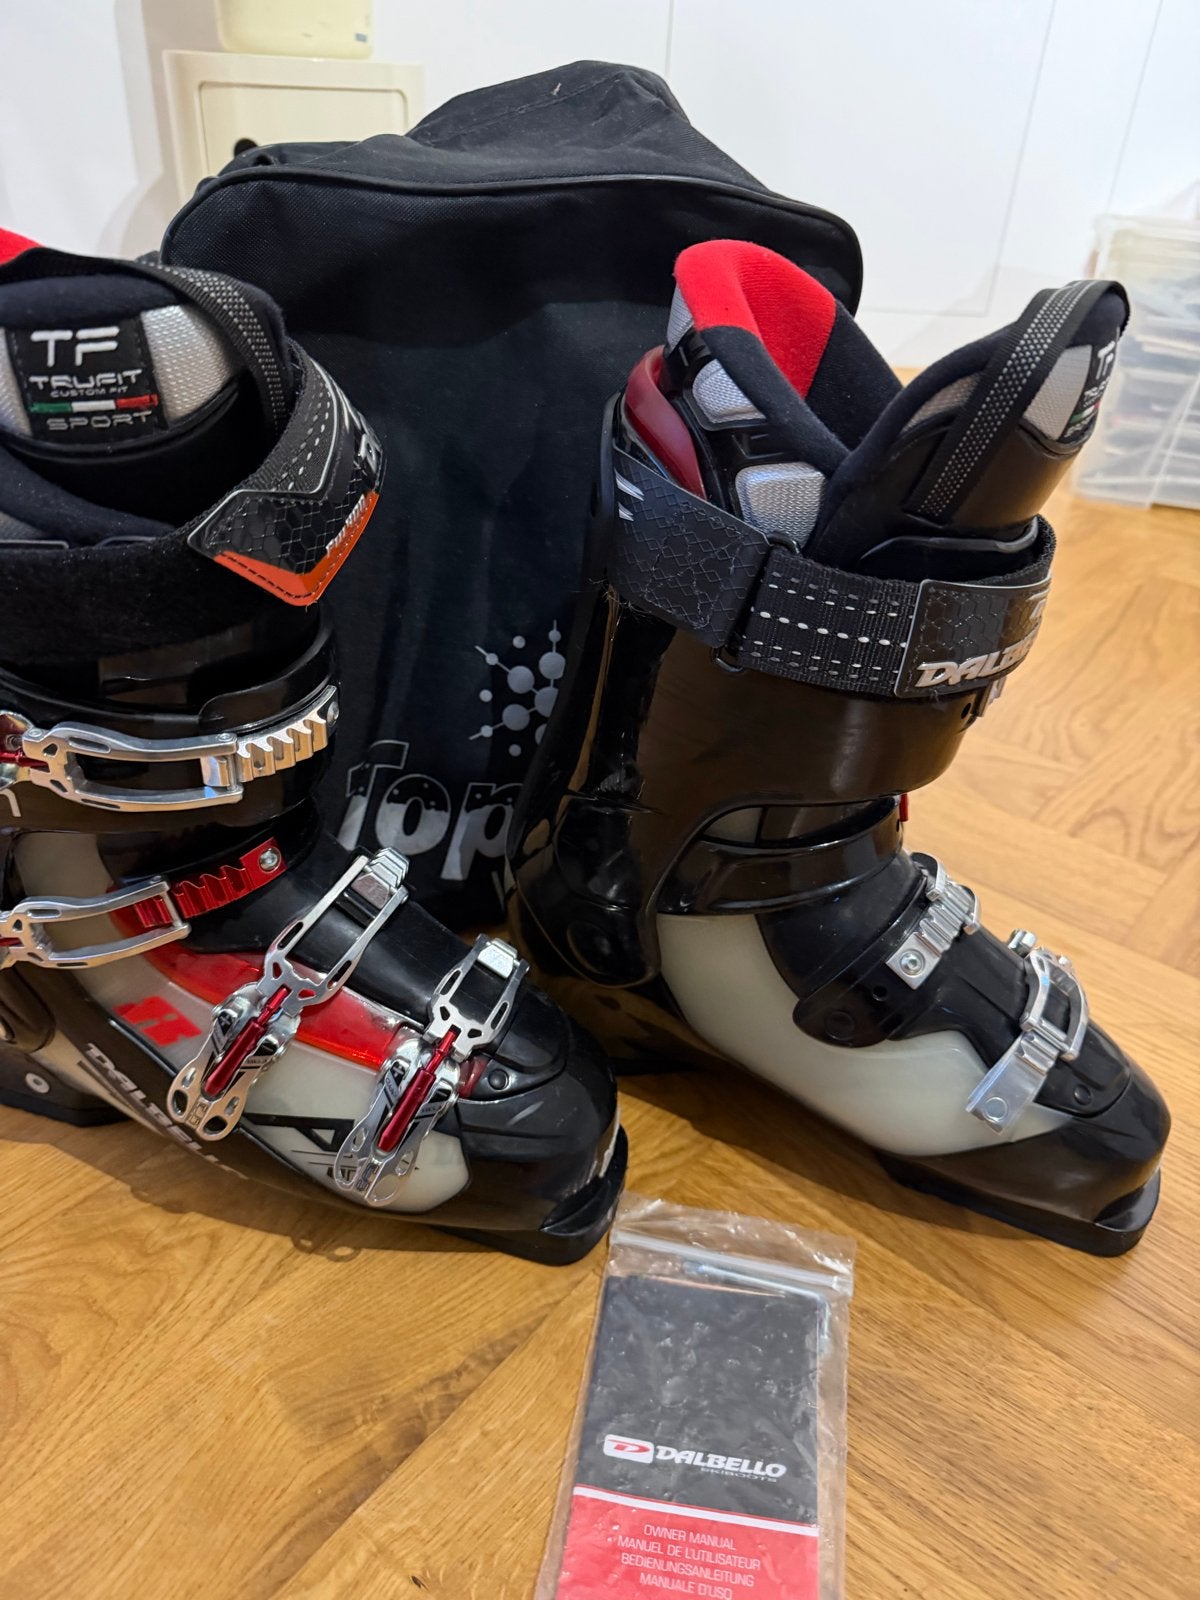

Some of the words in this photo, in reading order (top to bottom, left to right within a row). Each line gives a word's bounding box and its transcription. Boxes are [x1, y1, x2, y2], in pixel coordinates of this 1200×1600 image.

[30, 326, 120, 367] TF
[29, 369, 142, 390] TRUFIT
[51, 388, 107, 397] CUSTOM
[109, 386, 129, 394] FIT
[47, 410, 152, 430] SPORT
[656, 1445, 787, 1478] DALBELLO
[644, 1524, 686, 1542] OWNER
[689, 1531, 736, 1550] MANUAL
[618, 1535, 664, 1554] MANUEL
[667, 1544, 682, 1557] DE
[685, 1547, 760, 1570] L'UTILISATEUR
[621, 1552, 755, 1587] BEDIENUNGSANLEITUNG
[640, 1572, 695, 1594] MANUALE
